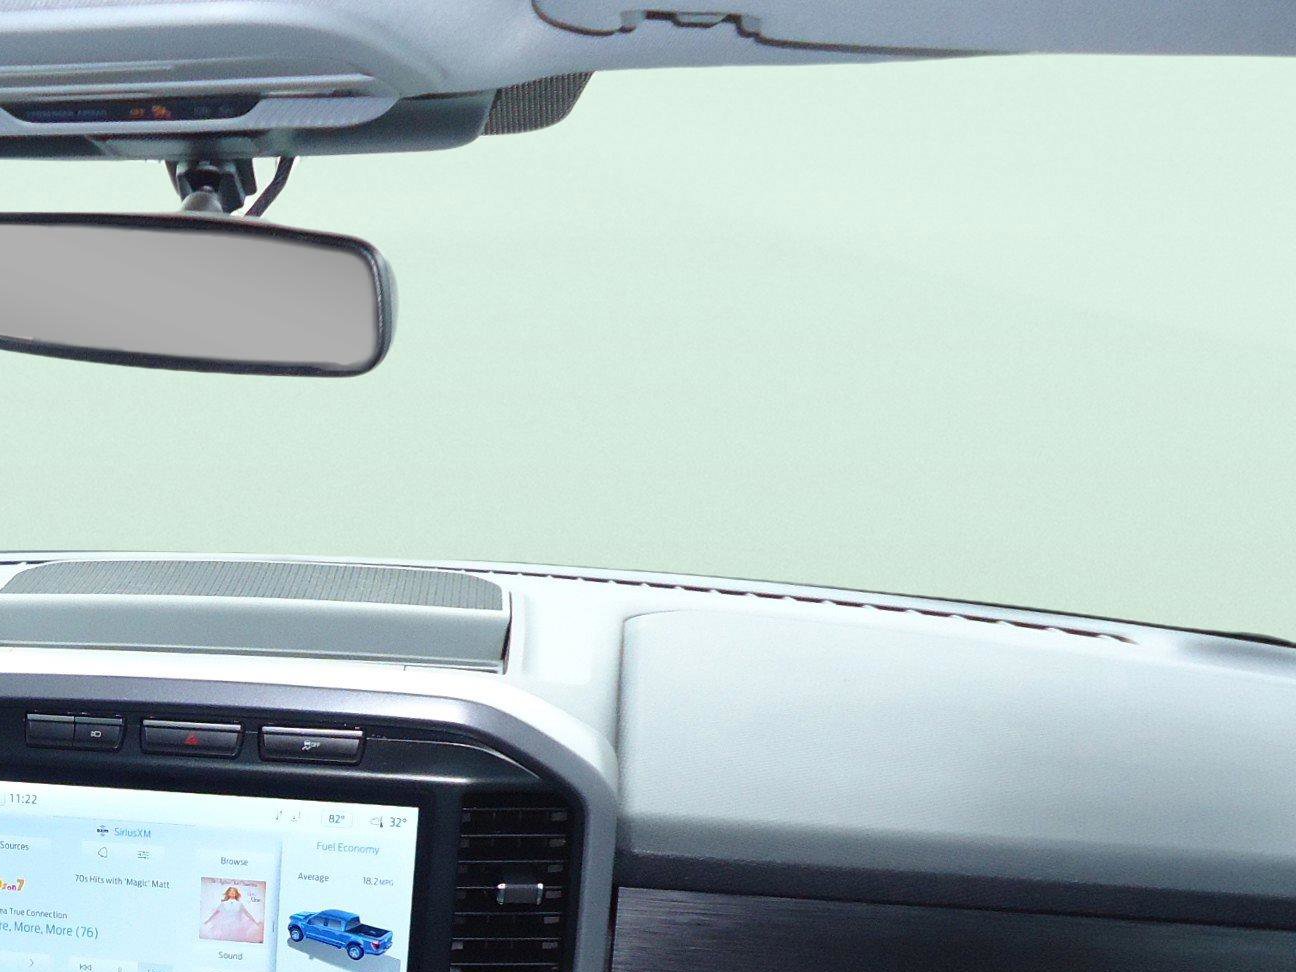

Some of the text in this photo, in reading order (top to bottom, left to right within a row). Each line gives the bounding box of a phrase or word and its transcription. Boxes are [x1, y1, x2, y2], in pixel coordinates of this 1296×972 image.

[10, 794, 38, 804] 11:22
[328, 814, 346, 824] 82°
[389, 816, 408, 828] 32°
[114, 827, 152, 839] SiriusXM
[0, 840, 30, 851] Sources
[316, 842, 380, 856] Fuel Economy
[220, 856, 249, 867] Browse
[74, 874, 88, 883] 70s
[89, 875, 104, 885] Hits
[104, 877, 123, 886] with
[152, 880, 170, 890] Matt
[298, 872, 330, 884] Average
[10, 907, 25, 917] True
[26, 908, 68, 920] Connection
[14, 921, 42, 934] More,
[46, 924, 73, 936] More
[76, 925, 99, 940] (76)
[218, 950, 244, 961] Sound
